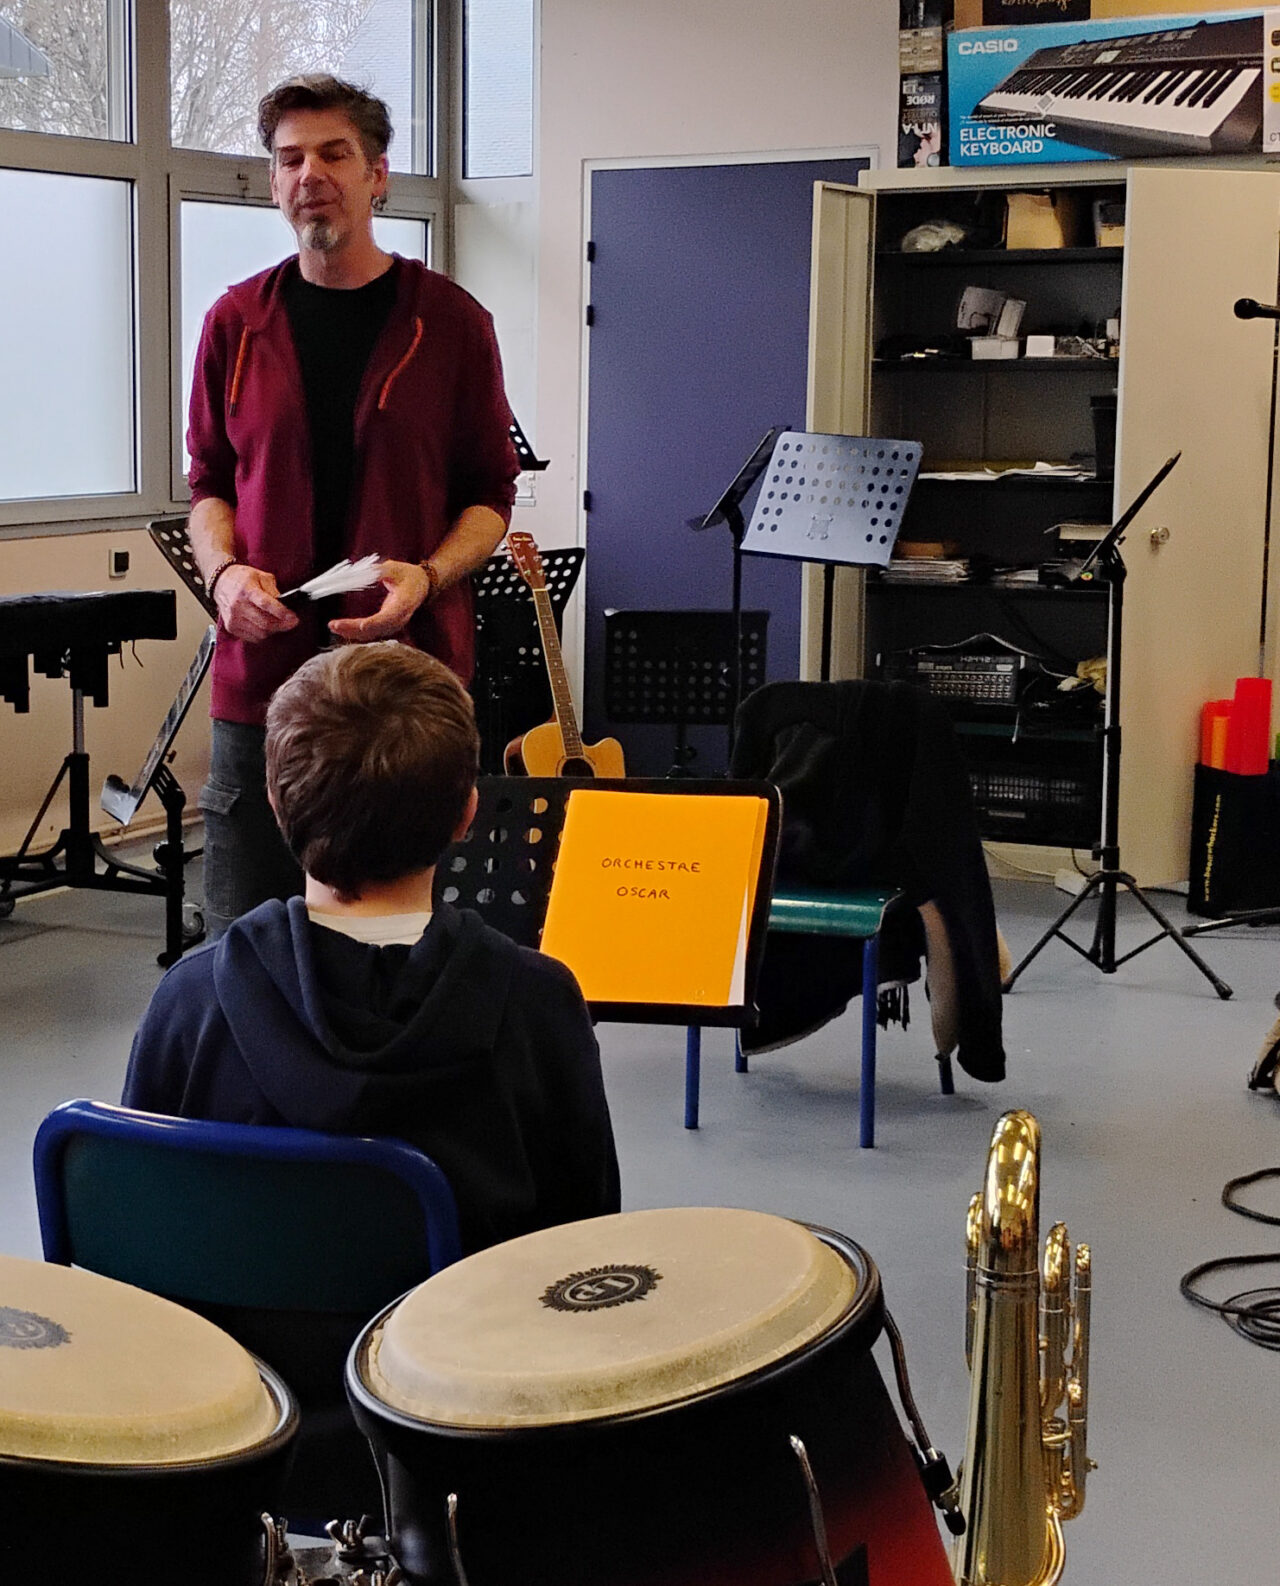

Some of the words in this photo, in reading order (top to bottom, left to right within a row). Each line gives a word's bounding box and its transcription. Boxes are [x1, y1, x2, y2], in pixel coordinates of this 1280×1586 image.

[958, 38, 1019, 55] CASIO
[960, 123, 1057, 142] ELECTRONIC
[960, 139, 1044, 157] KEYBOARD
[601, 857, 701, 873] ORCHESTRE
[616, 886, 671, 900] OSCAR
